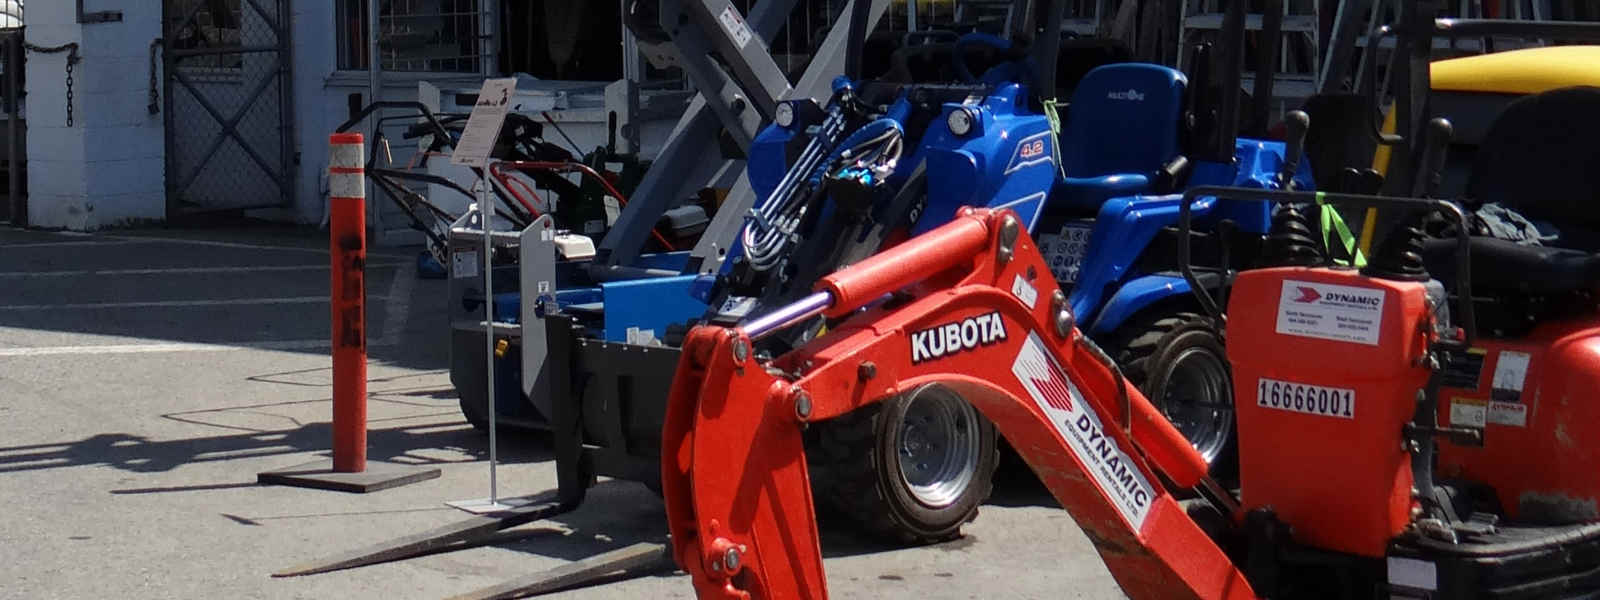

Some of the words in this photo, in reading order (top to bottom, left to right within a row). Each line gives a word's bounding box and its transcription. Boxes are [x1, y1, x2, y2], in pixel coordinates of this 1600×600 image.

[1020, 140, 1044, 157] 4.2
[1325, 292, 1380, 306] DYNAMIC
[911, 312, 1006, 362] KUBOTA
[1260, 381, 1351, 416] 16666001
[1064, 419, 1101, 465] EQUIPMENT
[1099, 465, 1128, 502] RENTALS
[1076, 414, 1147, 507] DYNAMIC
